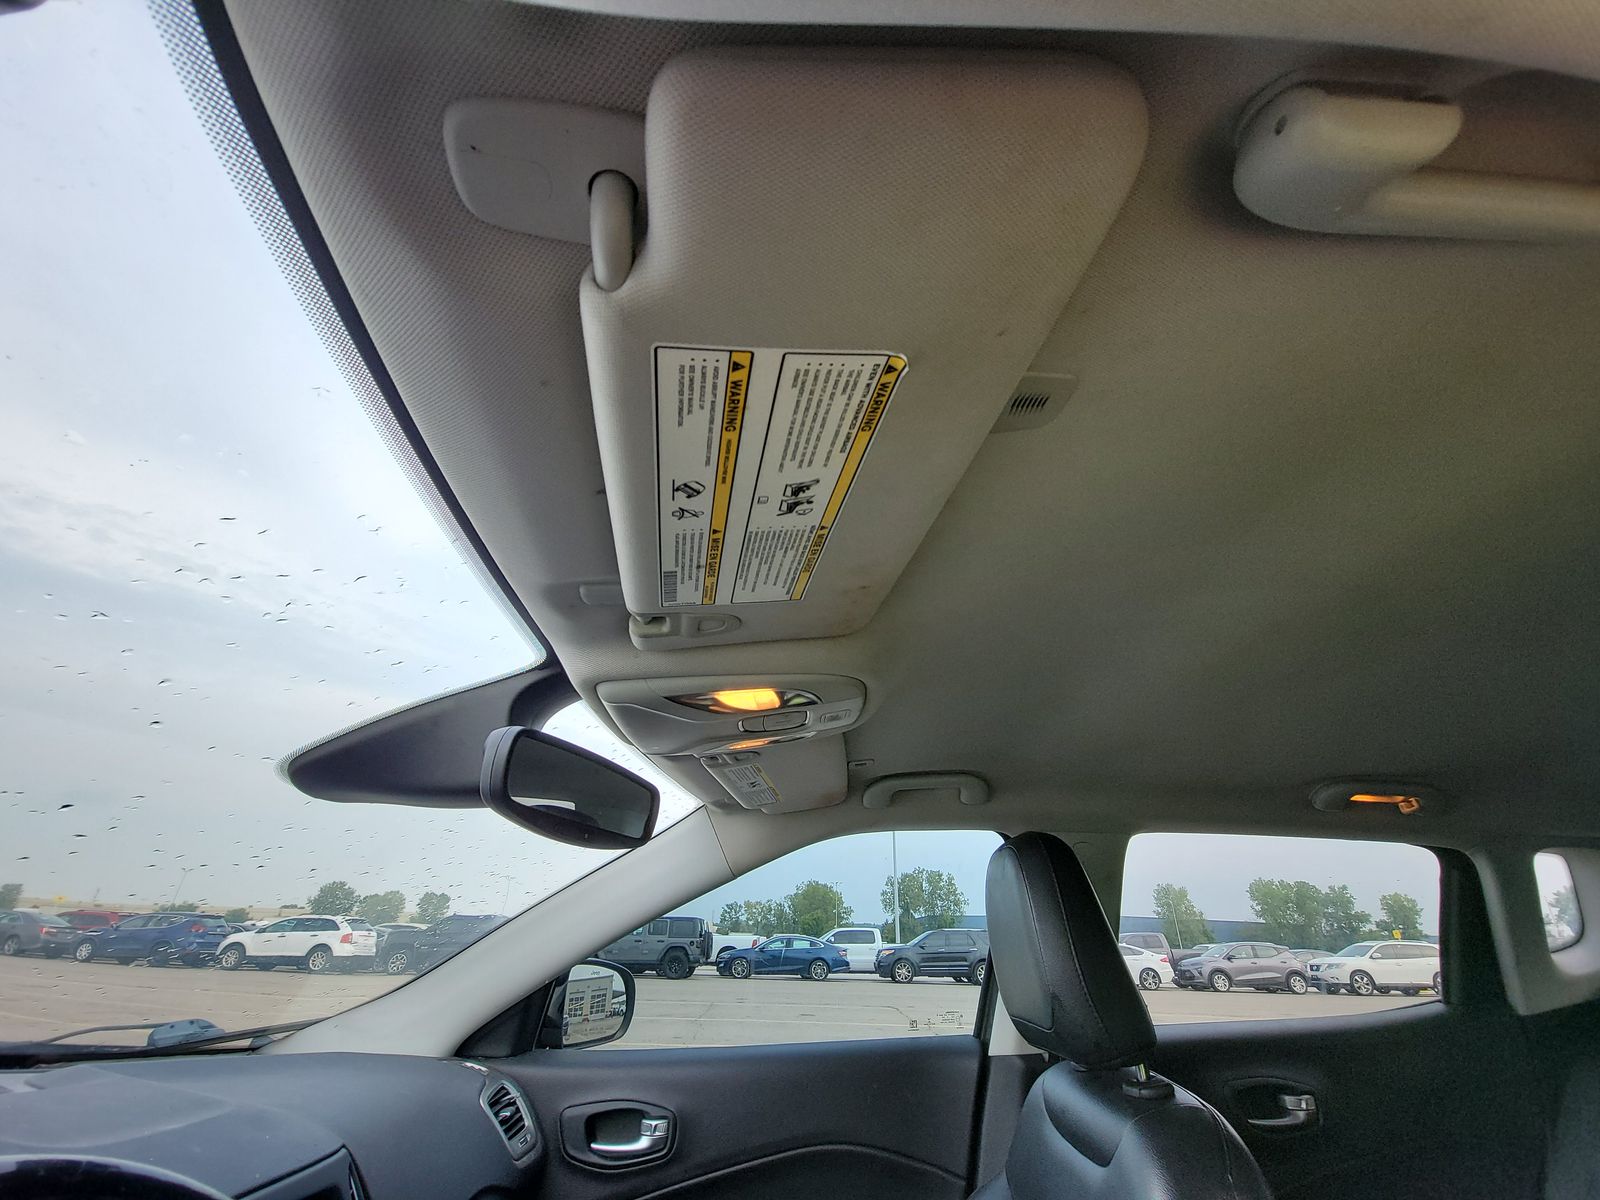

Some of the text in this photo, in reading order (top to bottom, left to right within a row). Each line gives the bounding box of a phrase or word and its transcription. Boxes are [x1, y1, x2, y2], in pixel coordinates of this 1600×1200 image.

[868, 364, 880, 380] EVEN
[861, 382, 873, 398] WITH
[725, 381, 742, 432] WARNING
[848, 400, 866, 430] ADVANCED
[860, 382, 891, 433] WARNING
